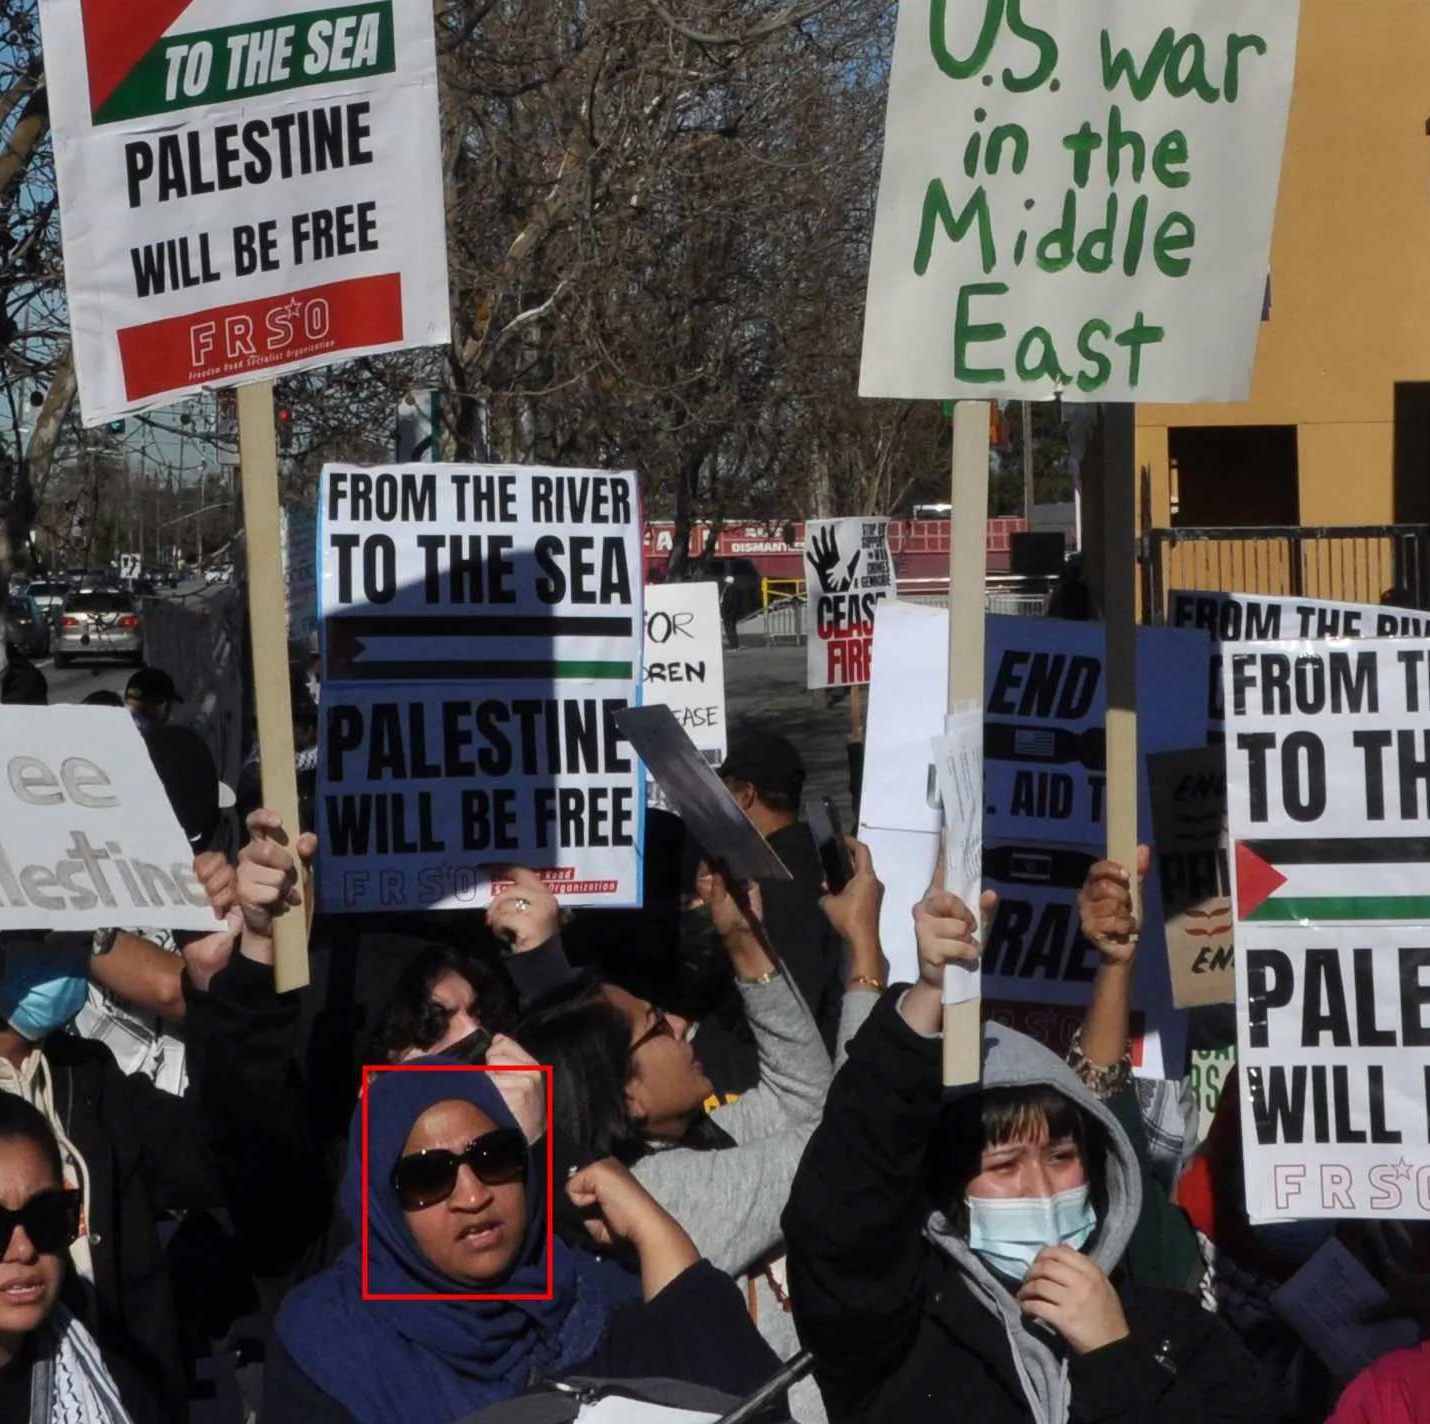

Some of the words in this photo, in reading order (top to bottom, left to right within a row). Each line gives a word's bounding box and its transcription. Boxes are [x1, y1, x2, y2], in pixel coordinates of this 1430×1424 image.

[164, 40, 213, 102] TO
[226, 24, 295, 91] THE
[303, 12, 380, 76] SEA
[1100, 26, 1267, 103] war
[124, 101, 374, 208] PALESTINE
[963, 107, 1029, 178] in
[1062, 104, 1191, 189] the
[130, 232, 221, 298] WILL
[233, 219, 280, 277] BE
[292, 200, 379, 266] FREE
[913, 177, 1195, 278] Middle
[954, 281, 1165, 392] East
[328, 473, 437, 522] FROM
[451, 476, 518, 523] THE
[532, 476, 631, 525] RIVER
[331, 534, 397, 604] TO
[417, 534, 514, 606] THE
[535, 535, 632, 606] SEA
[644, 611, 695, 643] OR
[817, 591, 886, 640] CEAS
[988, 651, 1102, 720] END
[1232, 651, 1379, 716] FROM
[328, 698, 631, 783] PALESTINE
[1237, 730, 1326, 822] TO
[325, 791, 445, 857] WILL
[461, 788, 519, 852] BE
[534, 787, 634, 850] FREE
[1010, 770, 1079, 819] AID
[1248, 1064, 1402, 1145] WILL
